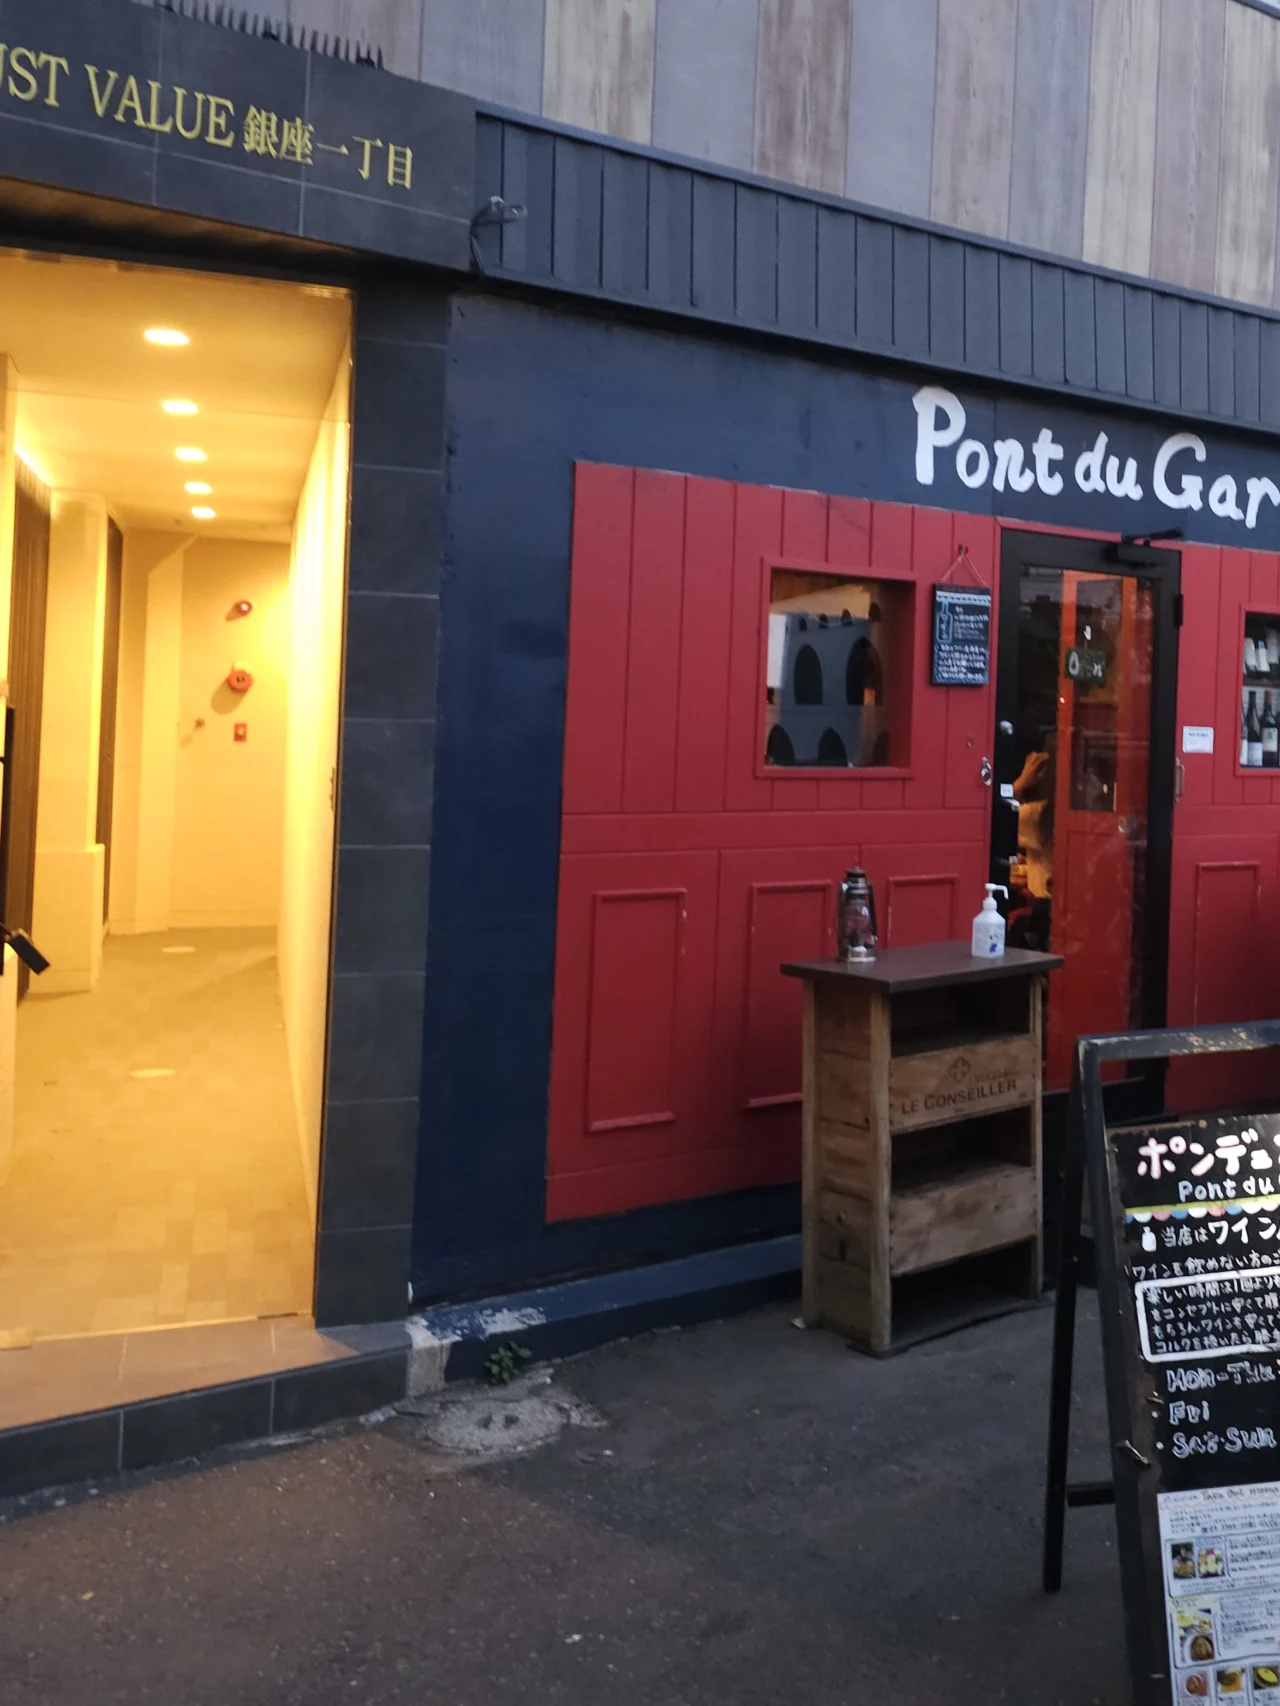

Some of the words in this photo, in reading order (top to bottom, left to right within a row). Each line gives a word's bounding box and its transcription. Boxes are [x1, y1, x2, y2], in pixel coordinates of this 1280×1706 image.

[84, 64, 235, 148] VALUE
[243, 104, 413, 190] 銀座一丁目
[911, 385, 1064, 497] Pont
[1074, 430, 1145, 501] du
[901, 1099, 920, 1115] LE
[924, 1078, 1017, 1110] CONSEILLER
[1178, 1179, 1236, 1202] Pont
[1243, 1176, 1274, 1195] du
[1168, 1400, 1210, 1425] Fri
